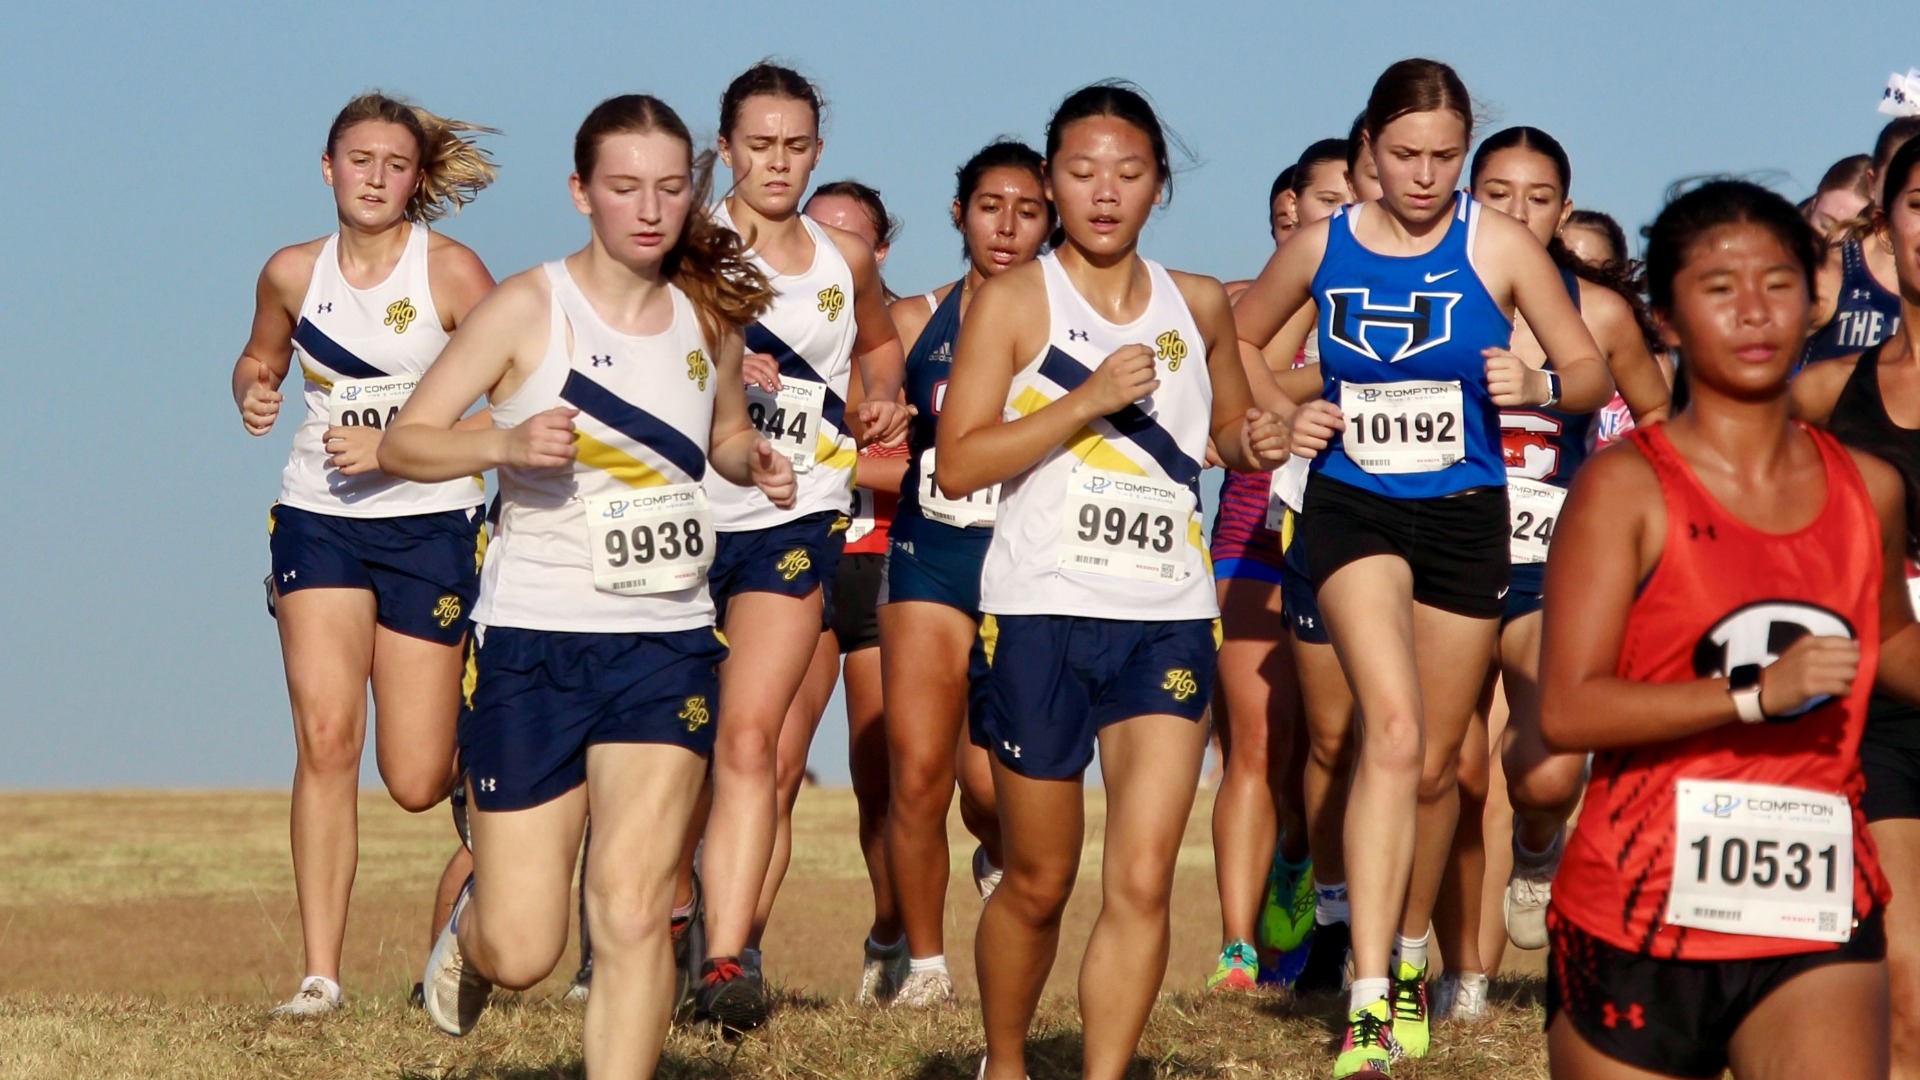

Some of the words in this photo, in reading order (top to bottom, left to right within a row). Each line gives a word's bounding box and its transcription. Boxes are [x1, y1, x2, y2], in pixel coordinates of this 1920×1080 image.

[1325, 288, 1464, 363] H
[1837, 311, 1884, 347] THE
[780, 385, 812, 396] PTON
[1385, 387, 1448, 397] COMPTON
[748, 402, 807, 445] 944
[1350, 411, 1456, 444] 10192
[633, 492, 695, 507] COMPTON
[1115, 481, 1176, 499] COMPTON
[1507, 483, 1555, 499] OMPTON
[605, 518, 704, 568] 9938
[1077, 503, 1174, 553] 9943
[1512, 510, 1554, 546] 24
[1747, 799, 1834, 816] COMPTON
[1690, 834, 1838, 893] 10531
